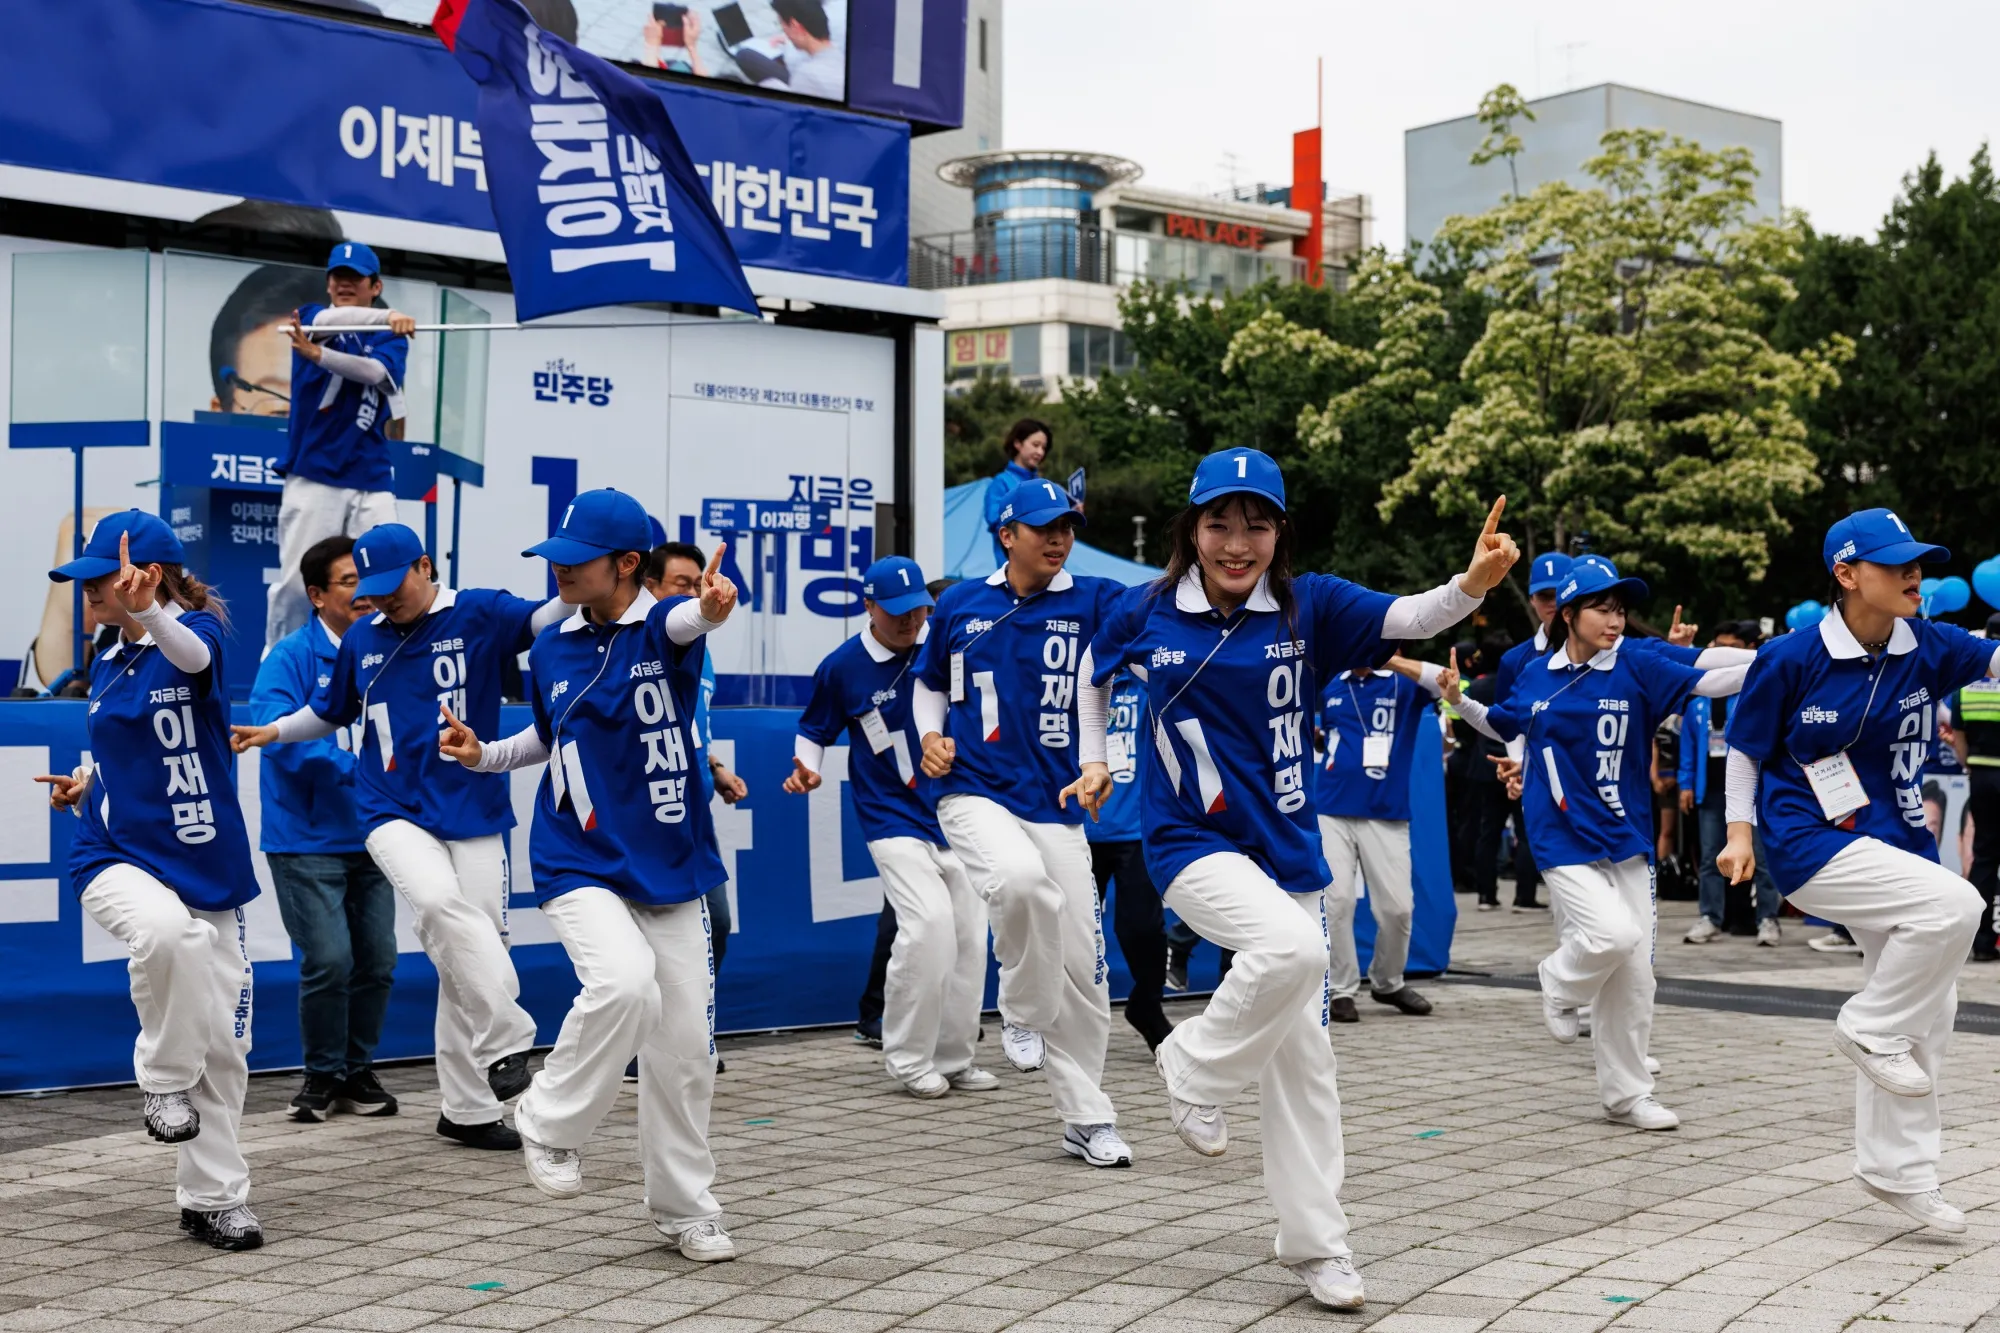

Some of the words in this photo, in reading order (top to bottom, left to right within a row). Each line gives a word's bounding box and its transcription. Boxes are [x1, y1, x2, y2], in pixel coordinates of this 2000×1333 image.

[1166, 212, 1266, 251] PALACE
[344, 245, 352, 258] 1
[955, 331, 1008, 362] 임대
[533, 371, 614, 407] 민주당
[694, 382, 760, 401] 더불어민주당
[763, 389, 797, 405] 제21대
[800, 393, 852, 410] 대통령선거
[855, 398, 875, 411] 후보
[1234, 456, 1247, 478] 1
[788, 474, 874, 511] 지금은
[1042, 483, 1057, 500] 1
[231, 502, 281, 523] 이제부
[562, 505, 575, 529] 1
[746, 503, 757, 528] 1
[760, 511, 811, 530] 이재명
[1886, 513, 1906, 533] 1
[231, 524, 263, 544] 진짜
[360, 548, 370, 568] 1
[1833, 544, 1857, 563] 이재명
[898, 568, 910, 586] 1
[1545, 561, 1554, 576] 1
[1599, 564, 1614, 578] 1
[965, 622, 993, 635] 민주당
[1045, 620, 1080, 634] 지금은
[431, 638, 465, 653] 지금은
[1264, 640, 1306, 659] 지금은
[629, 659, 664, 680] 지금은
[1151, 651, 1187, 668] 민주당
[150, 686, 192, 704] 지금은
[1039, 635, 1077, 749] 이재명
[1898, 687, 1930, 712] 지금은
[972, 671, 1000, 743] 1
[1597, 699, 1629, 712] 지금은
[1801, 709, 1839, 725] 민주당
[367, 702, 397, 773] 1
[1267, 659, 1306, 814] 이재명
[634, 678, 689, 825] 이재명
[153, 704, 217, 846] 이재명
[1889, 704, 1932, 828] 이재명
